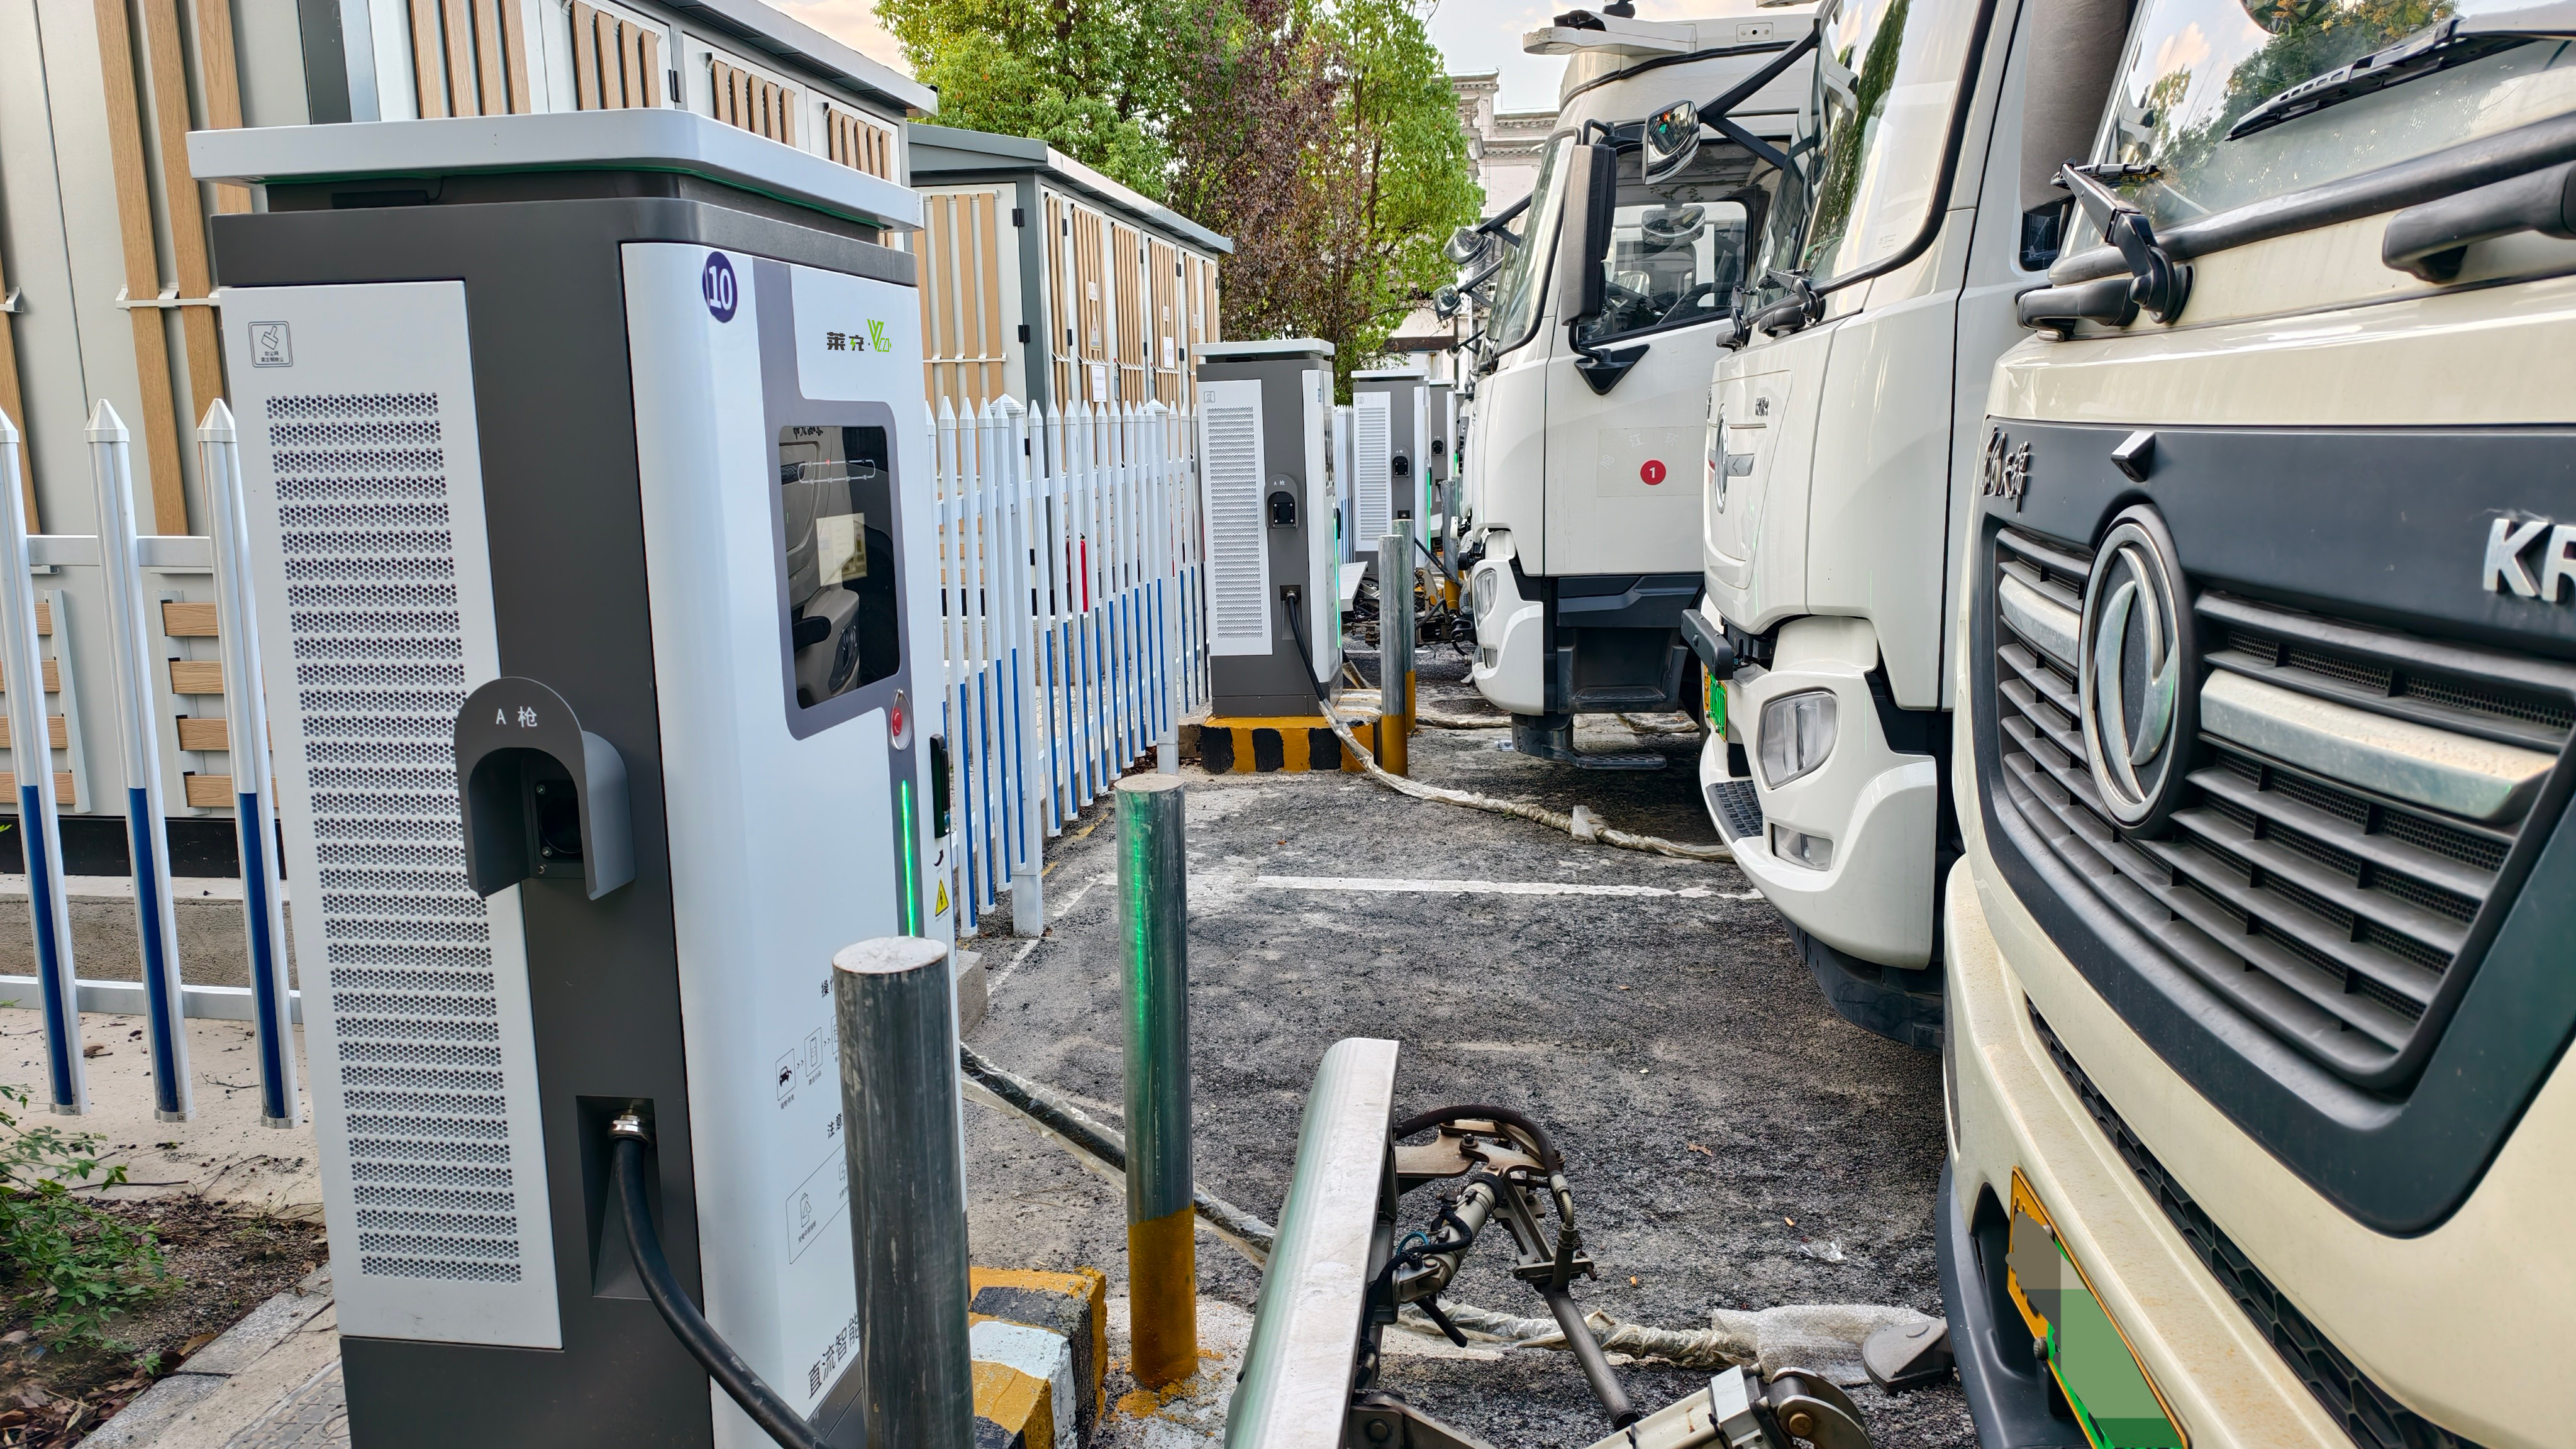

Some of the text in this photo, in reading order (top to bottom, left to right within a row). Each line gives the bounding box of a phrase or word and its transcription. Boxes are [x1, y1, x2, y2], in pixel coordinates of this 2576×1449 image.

[709, 265, 733, 311] 10
[1649, 460, 1656, 479] 1
[496, 706, 538, 728] A 枪
